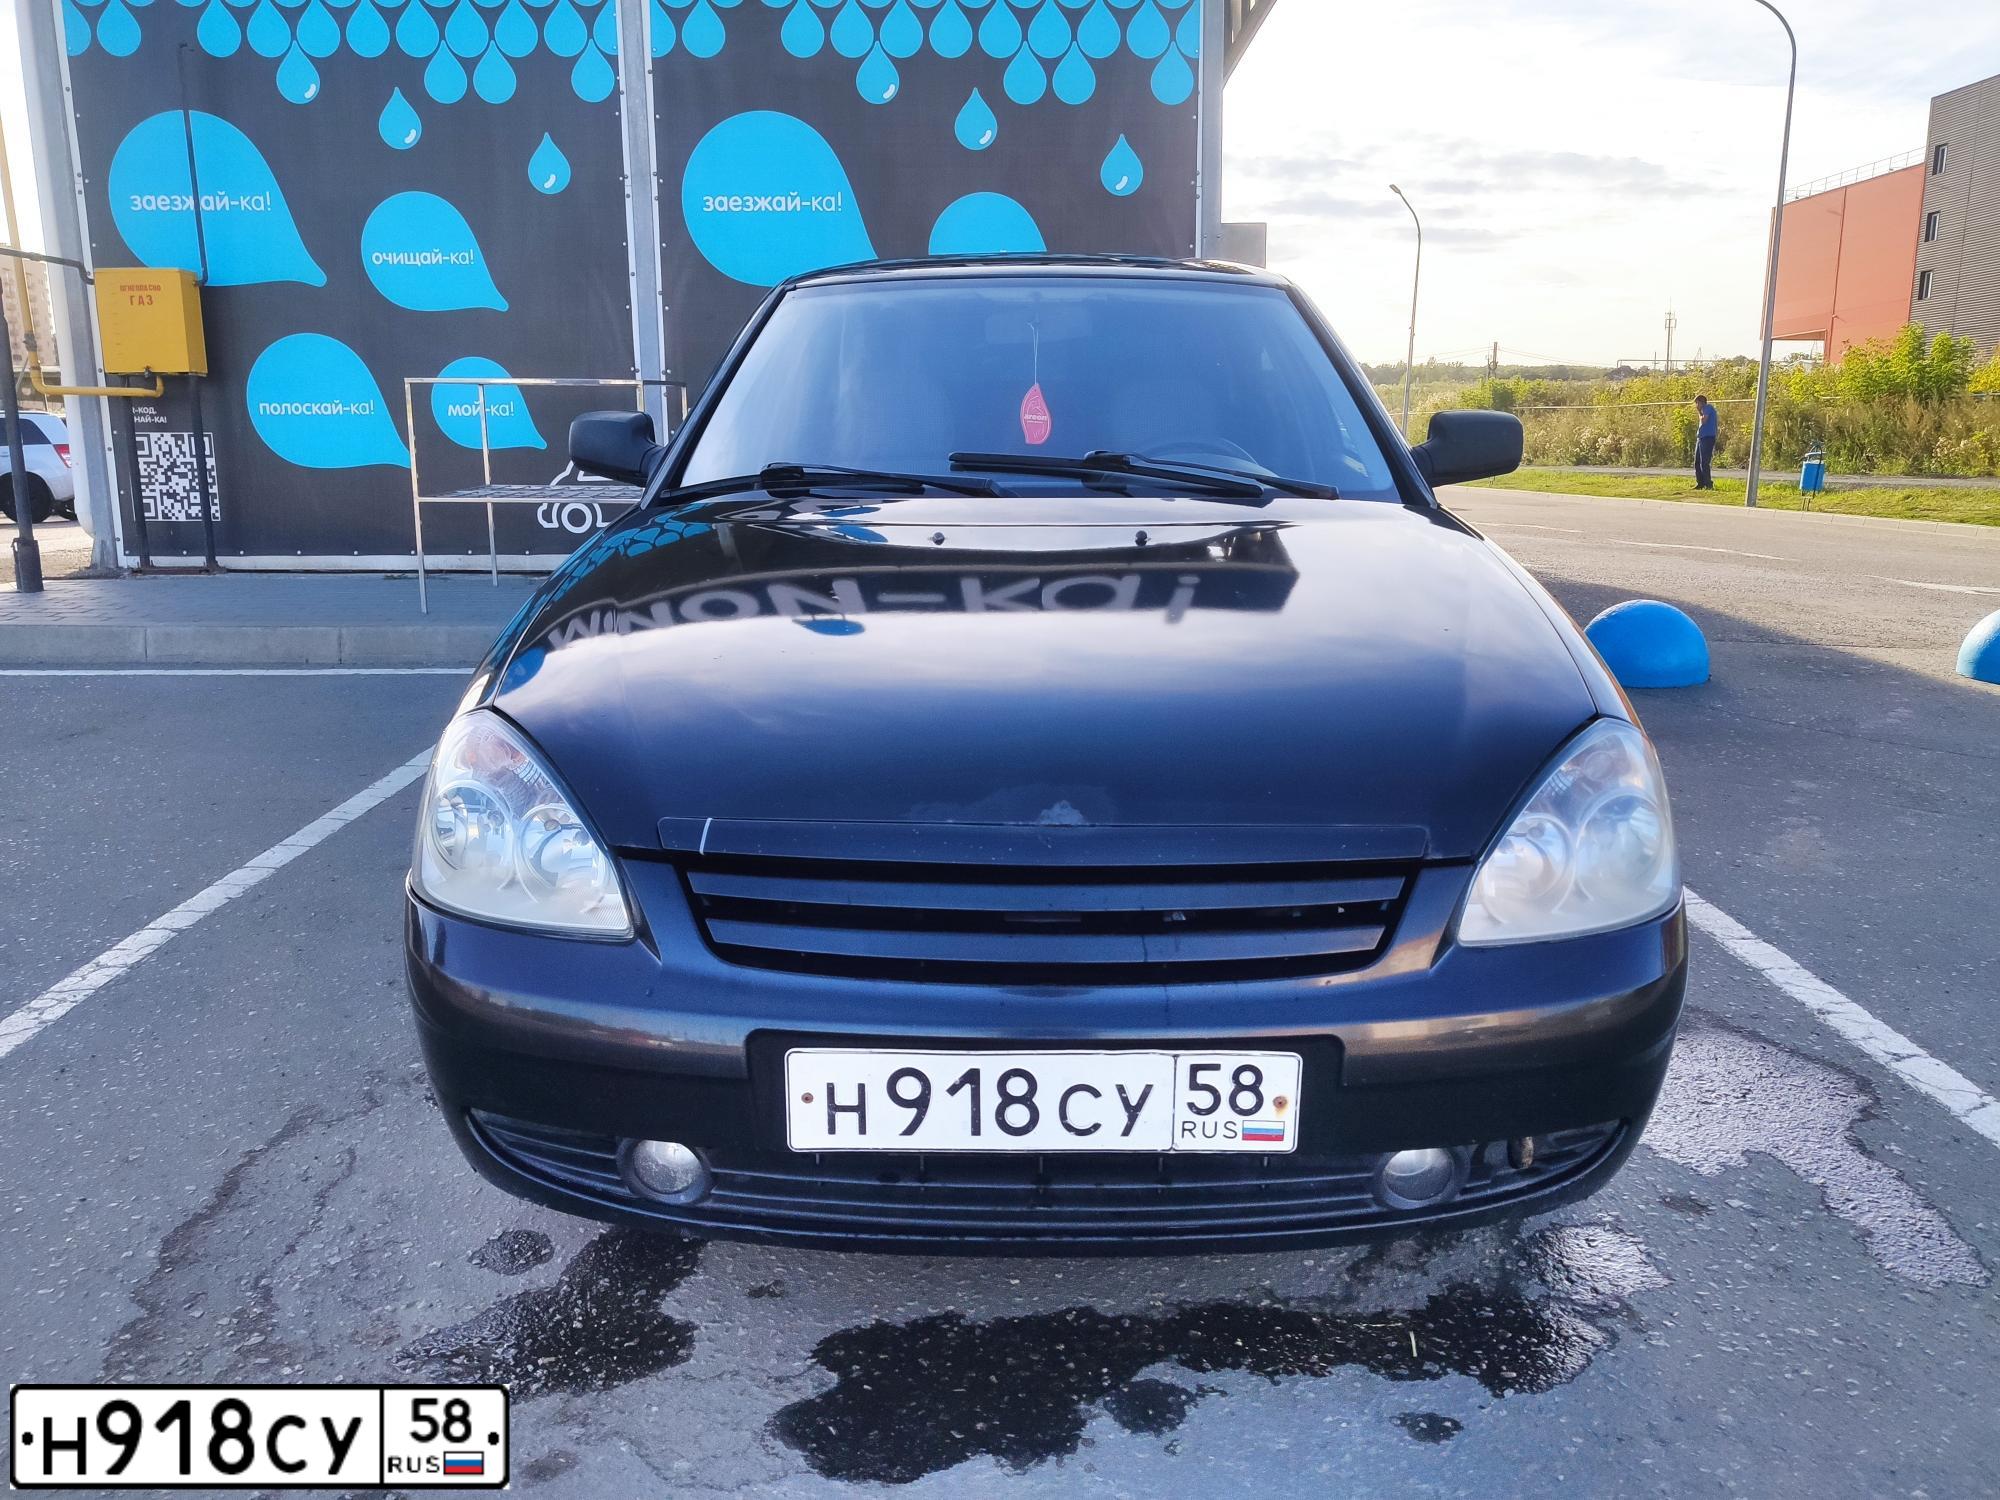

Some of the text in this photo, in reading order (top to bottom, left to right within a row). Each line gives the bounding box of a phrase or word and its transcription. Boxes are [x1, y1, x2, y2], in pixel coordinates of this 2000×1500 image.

[130, 191, 271, 211] заезжай-ка!
[703, 191, 842, 211] заезжай-ка!
[372, 248, 474, 266] очищай-ка!
[130, 295, 154, 306] ГАЗ
[259, 399, 374, 415] полоскай-ка!
[447, 401, 514, 417] мой-ка!
[1186, 1063, 1264, 1117] 58
[1181, 1120, 1238, 1139] RUS
